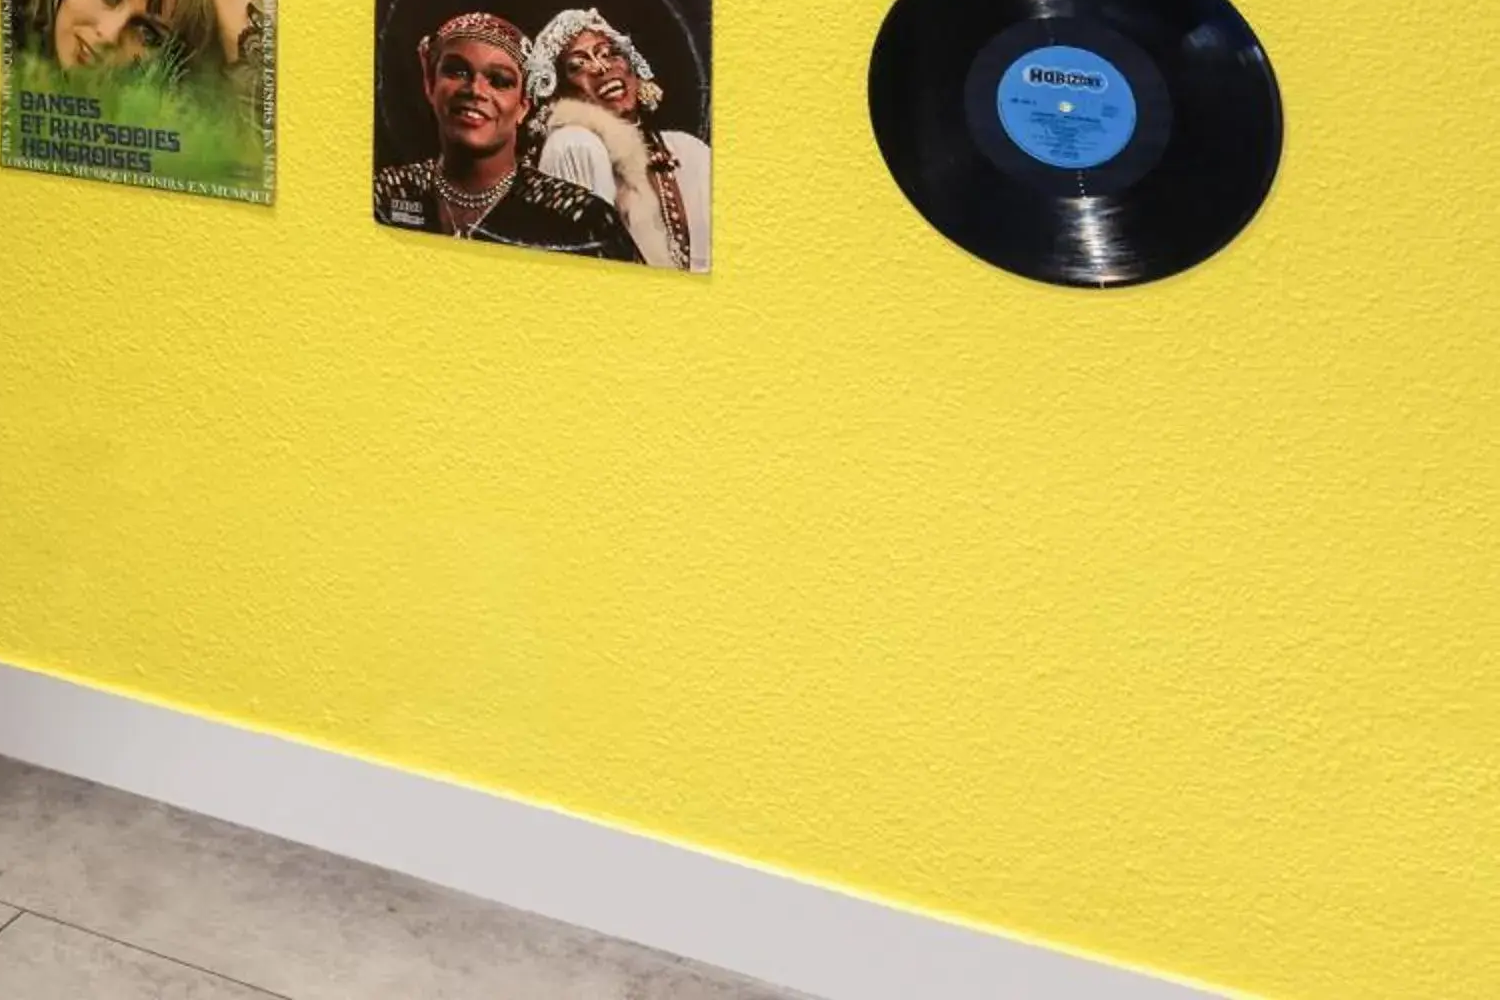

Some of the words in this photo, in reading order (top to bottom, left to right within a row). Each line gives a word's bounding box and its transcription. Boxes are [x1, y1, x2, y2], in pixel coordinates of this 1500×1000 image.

[20, 90, 101, 119] DANSES
[20, 114, 44, 134] ET
[50, 117, 181, 152] RHAPSODIES
